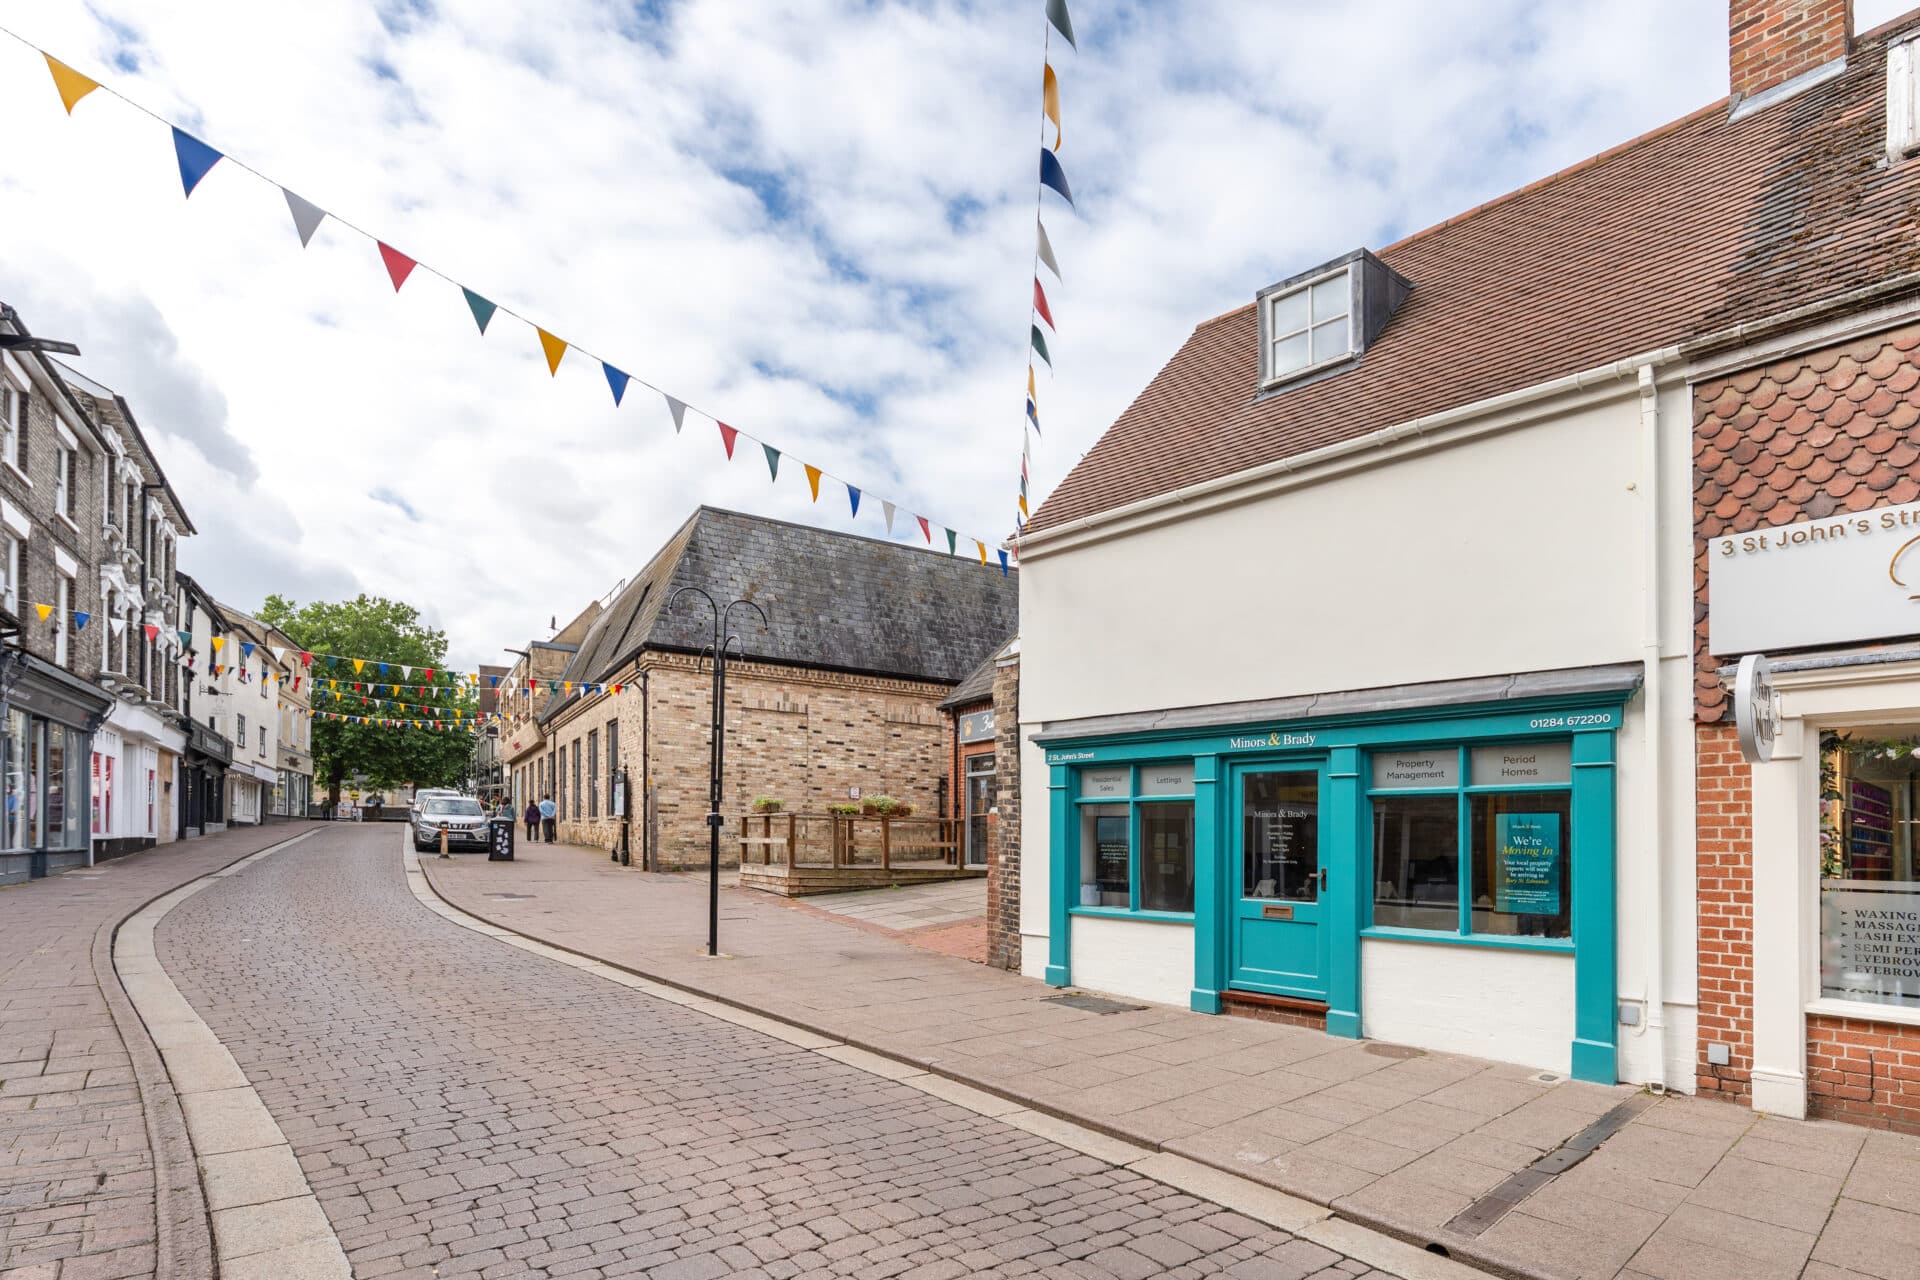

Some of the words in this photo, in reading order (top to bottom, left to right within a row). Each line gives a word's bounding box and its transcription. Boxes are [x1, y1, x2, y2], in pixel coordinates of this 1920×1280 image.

[1721, 540, 1734, 556] 3
[1743, 535, 1767, 553] St
[1776, 518, 1870, 546] John's
[1530, 717, 1564, 729] 01284
[1566, 713, 1611, 726] 672200
[1230, 737, 1266, 749] Minors
[1268, 732, 1280, 746] &
[1283, 732, 1316, 747] Brady
[1078, 751, 1095, 760] Street
[1503, 754, 1536, 765] Period
[1396, 760, 1435, 769] Property
[1386, 771, 1445, 781] Management
[1501, 767, 1538, 777] Homes
[1156, 776, 1182, 785] Lettings
[1287, 810, 1308, 819] Brady
[1512, 836, 1542, 846] We're
[1502, 846, 1540, 857] Moving
[1542, 846, 1553, 855] In
[1854, 910, 1917, 920] WAXING
[1854, 931, 1893, 942] LASH
[1854, 943, 1890, 954] SEMI
